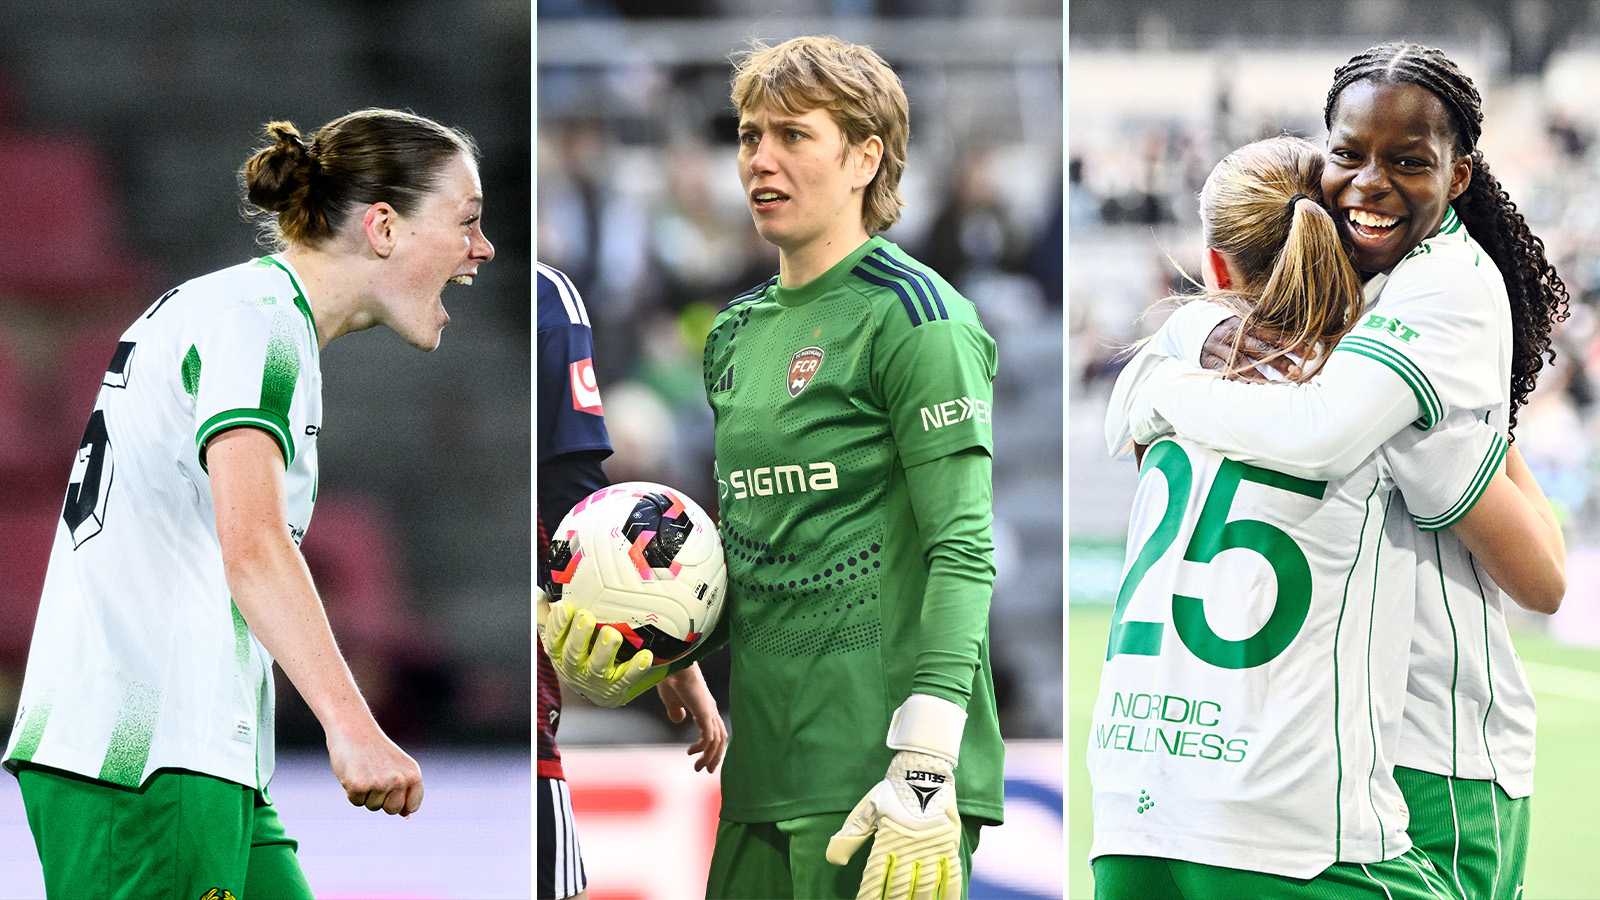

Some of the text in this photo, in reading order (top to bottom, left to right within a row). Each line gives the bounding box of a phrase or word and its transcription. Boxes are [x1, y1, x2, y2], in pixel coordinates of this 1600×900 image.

[1362, 314, 1420, 342] BST
[791, 359, 818, 374] FCR
[1106, 440, 1328, 669] 25
[1111, 692, 1222, 727] NORDIC
[1096, 723, 1249, 763] WELLNESS
[905, 770, 946, 784] SELECT
